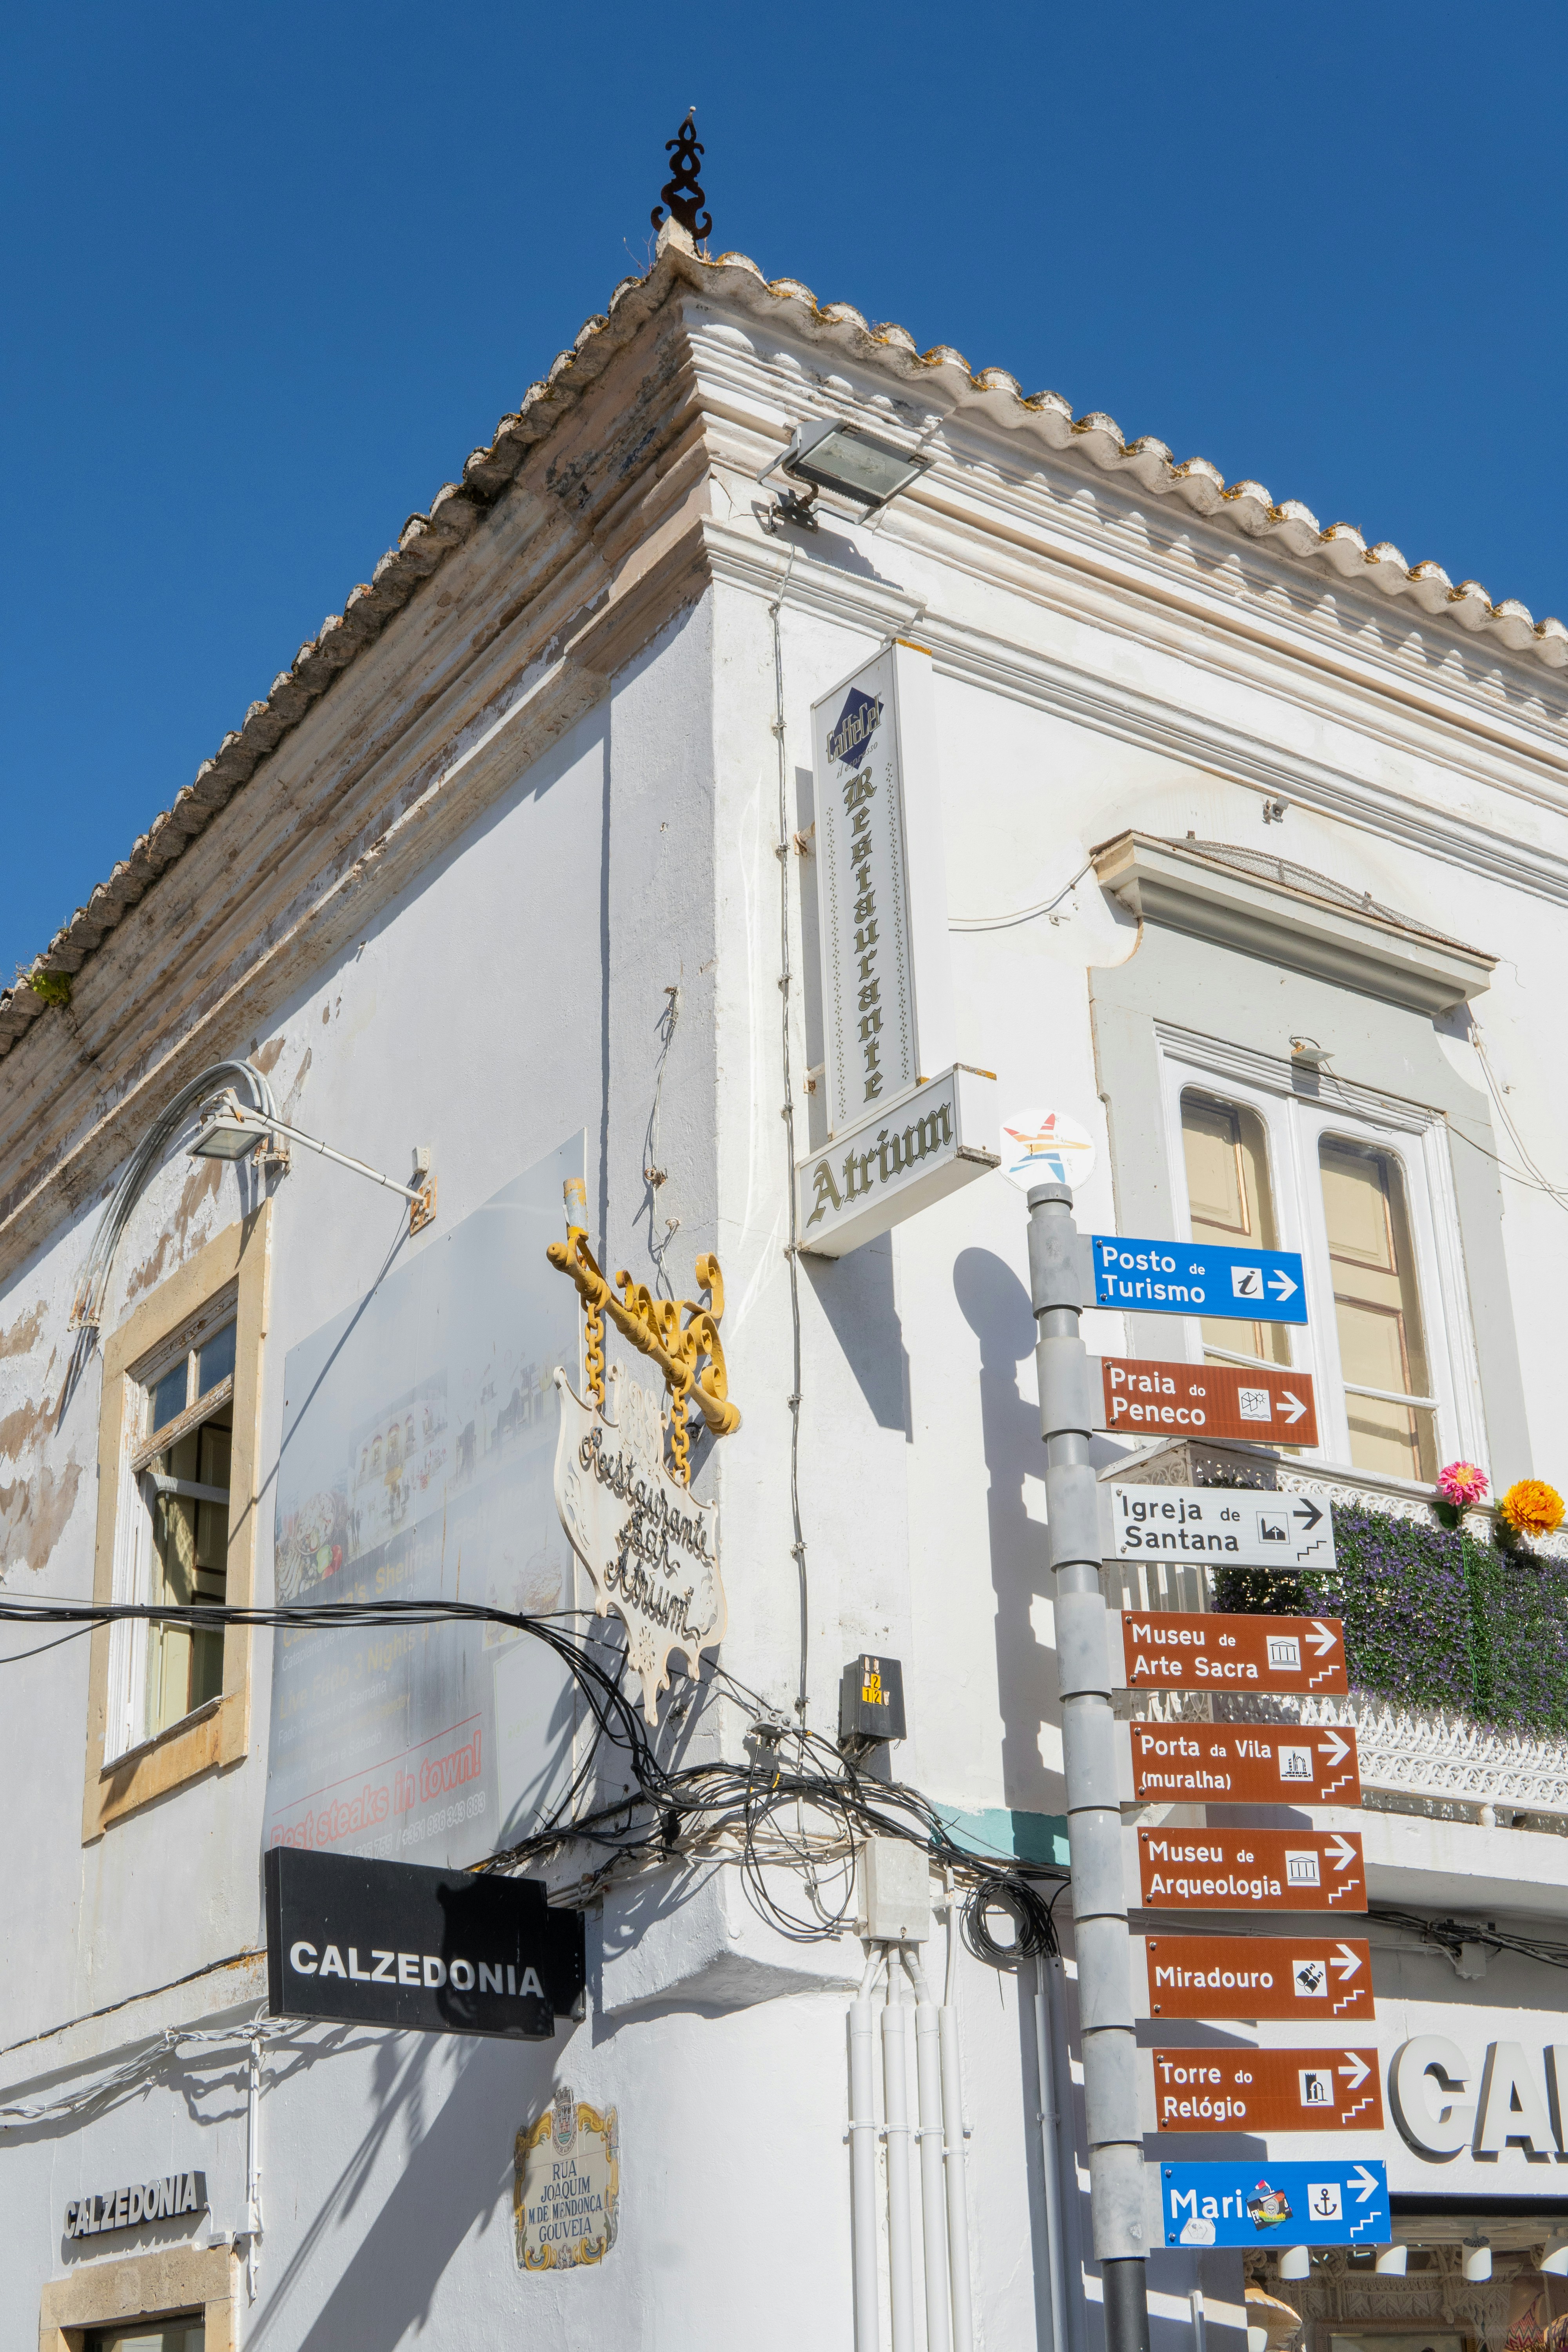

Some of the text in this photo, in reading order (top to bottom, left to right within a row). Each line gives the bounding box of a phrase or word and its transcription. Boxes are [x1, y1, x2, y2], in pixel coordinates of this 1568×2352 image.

[837, 742, 878, 779] il espresso
[843, 766, 884, 1103] Restaurante
[806, 1102, 953, 1227] Atrium
[1102, 1245, 1205, 1276] Posto de
[1102, 1275, 1205, 1303] Turismo
[1111, 1367, 1206, 1397] Praia do
[1112, 1397, 1205, 1426] Peneco
[1122, 1495, 1240, 1524] Igreja de
[1125, 1526, 1239, 1552] Santana
[1132, 1624, 1236, 1647] Museu de
[282, 1639, 322, 1672] Cataplana
[368, 1629, 416, 1673] Nights
[1134, 1655, 1258, 1679] Arte Sacra
[349, 1680, 387, 1708] Semana
[873, 1676, 878, 1689] 2
[1141, 1735, 1272, 1759] Porta da Vila
[316, 1784, 390, 1847] steaks
[394, 1769, 416, 1816] in
[419, 1729, 482, 1803] town!
[1142, 1771, 1231, 1790] (muralha)
[427, 1809, 446, 1837] 936
[446, 1801, 465, 1830] 343
[466, 1791, 486, 1818] 883
[1149, 1841, 1254, 1863] Museu de
[1150, 1874, 1281, 1899] Arqueologia
[290, 1942, 544, 1998] CALZEDONIA
[1155, 1966, 1274, 1989] Miradouro
[1159, 2063, 1253, 2084] Torre do
[1163, 2096, 1246, 2121] Relógio
[553, 2160, 577, 2181] RUA
[541, 2176, 590, 2203] JOAQUIM
[1171, 2188, 1252, 2218] Mari
[63, 2170, 207, 2239] CALZEDONIA
[537, 2205, 549, 2224] DE
[553, 2194, 603, 2220] MENDONÇA
[539, 2216, 592, 2243] GOUVEIA
